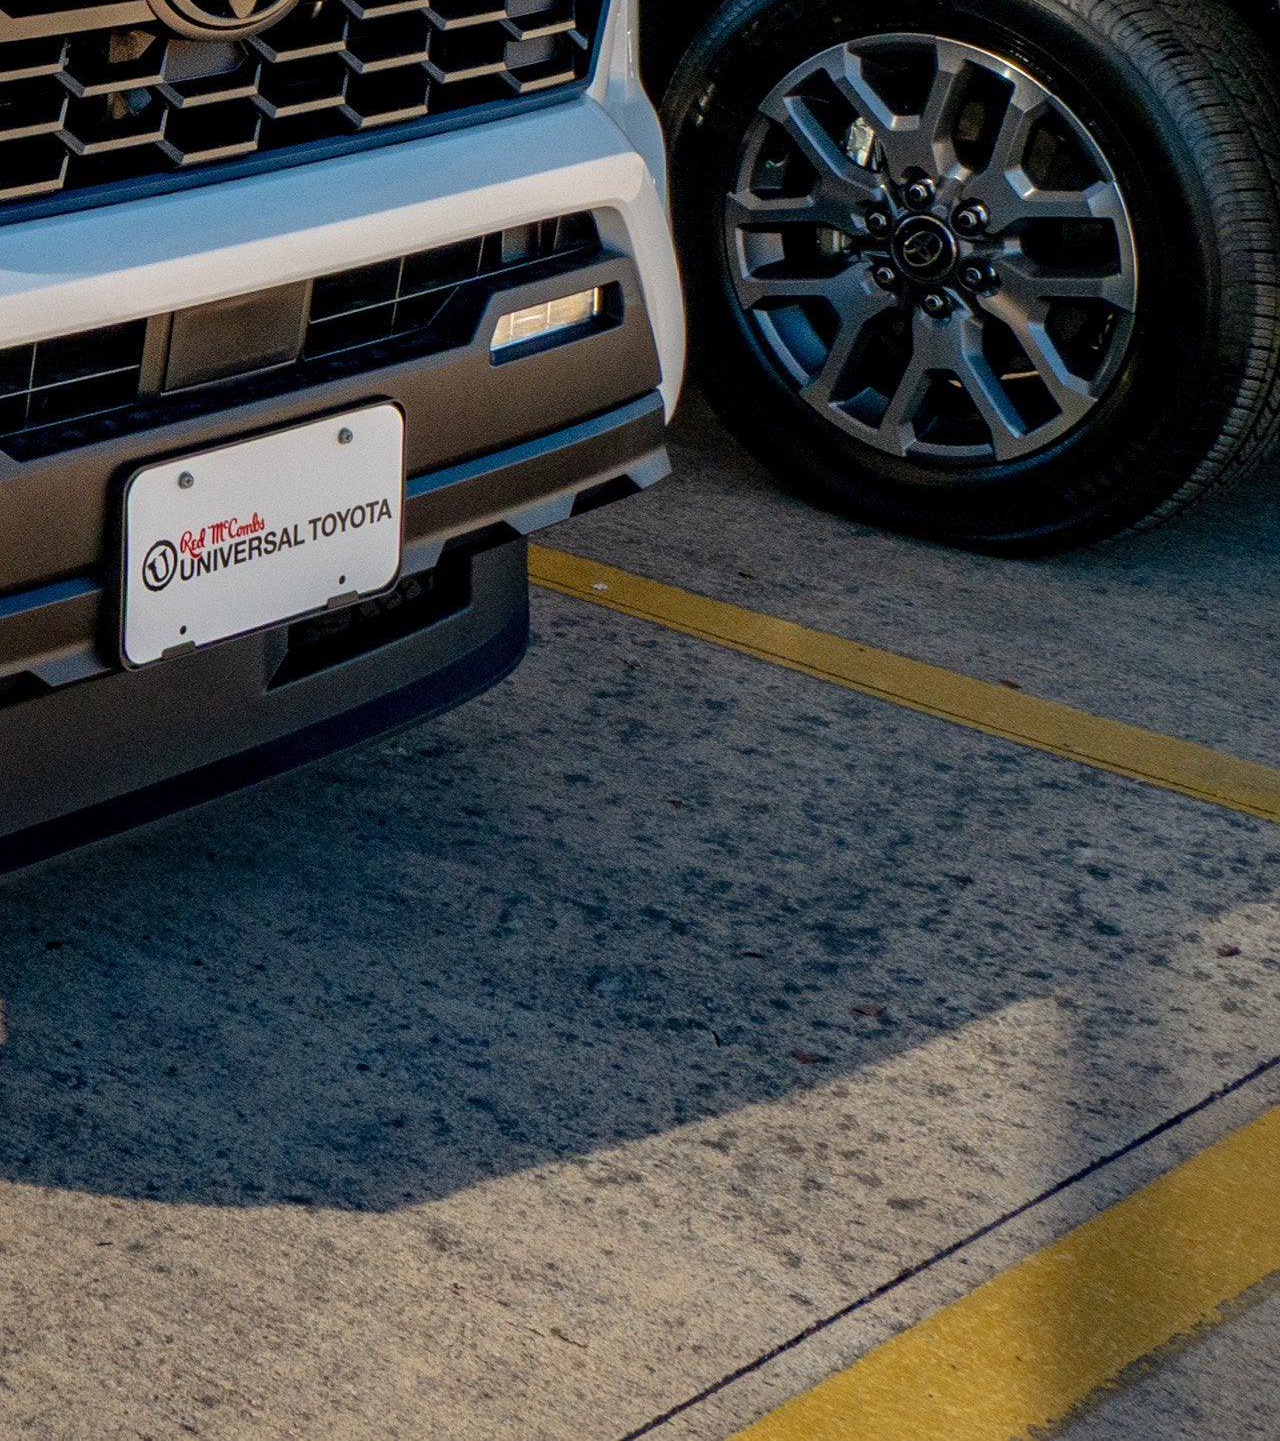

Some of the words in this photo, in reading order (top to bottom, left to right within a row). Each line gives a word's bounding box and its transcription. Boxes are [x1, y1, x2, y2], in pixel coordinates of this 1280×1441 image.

[180, 530, 206, 559] Red
[208, 512, 265, 545] McCombs
[180, 524, 305, 581] UNIVERSAL
[308, 498, 392, 541] TOYOTA
